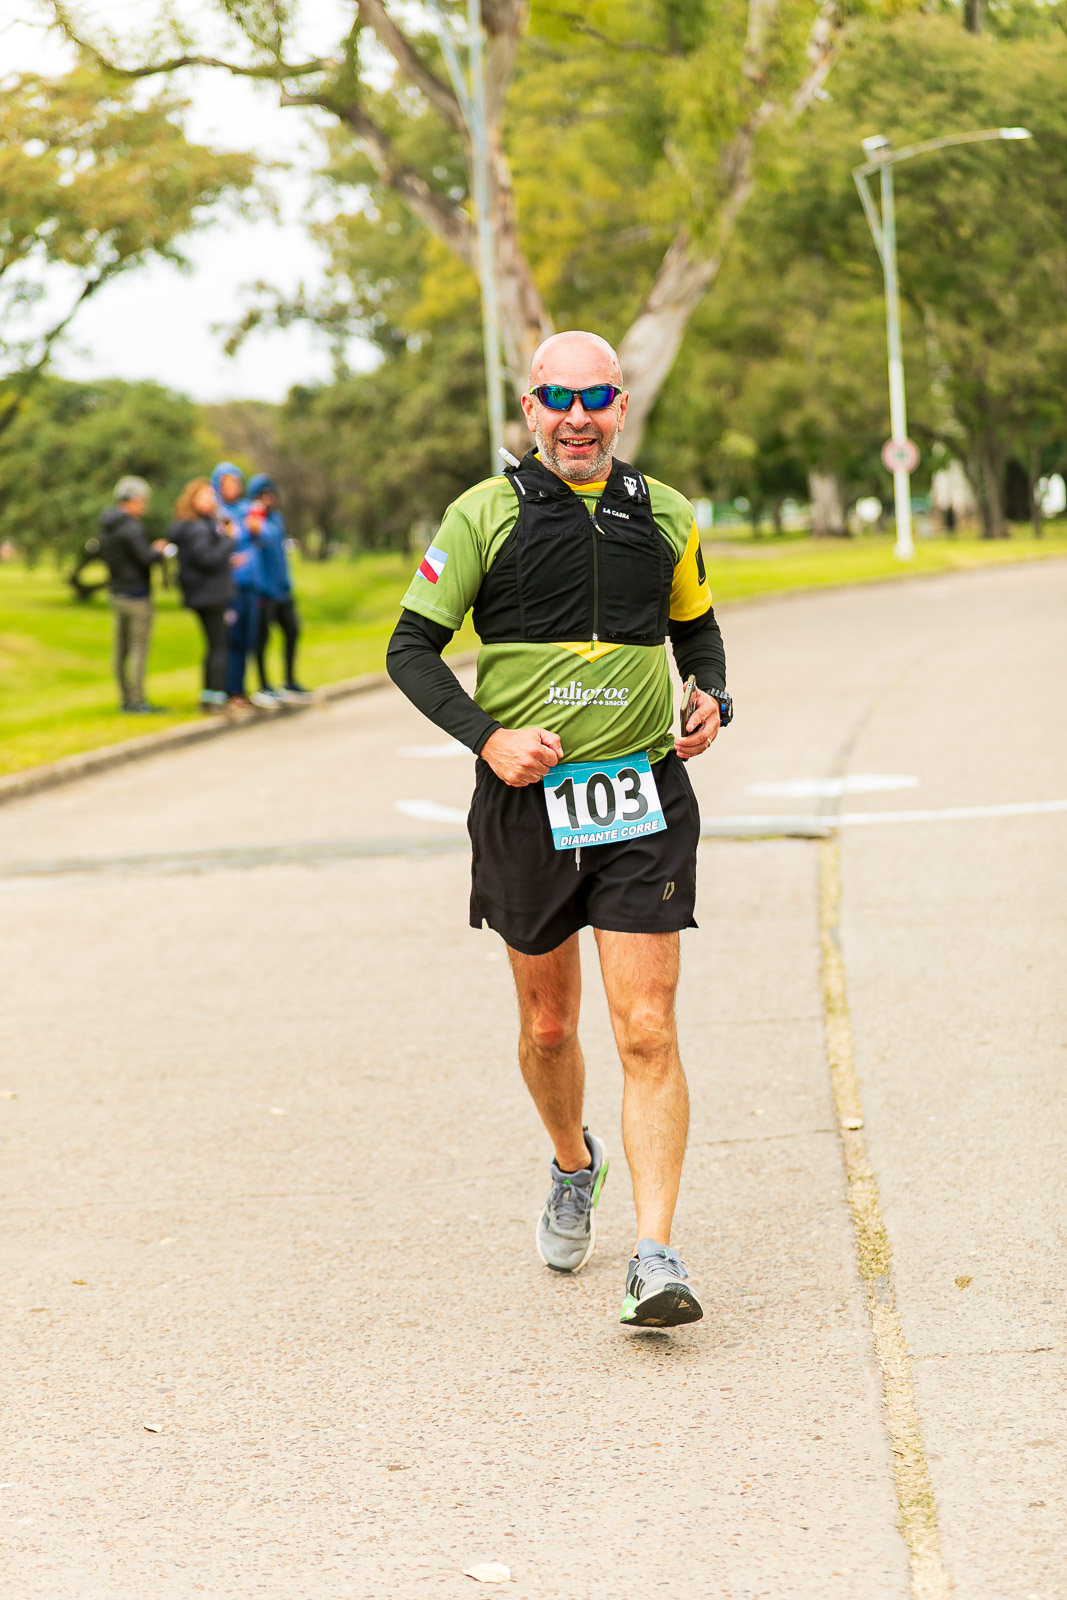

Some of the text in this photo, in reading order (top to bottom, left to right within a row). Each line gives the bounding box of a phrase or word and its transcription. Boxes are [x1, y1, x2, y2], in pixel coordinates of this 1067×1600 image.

[602, 507, 611, 515] LA
[544, 680, 629, 705] julicroc
[553, 767, 649, 830] 103
[560, 820, 659, 847] DIAMANTE CORRE
